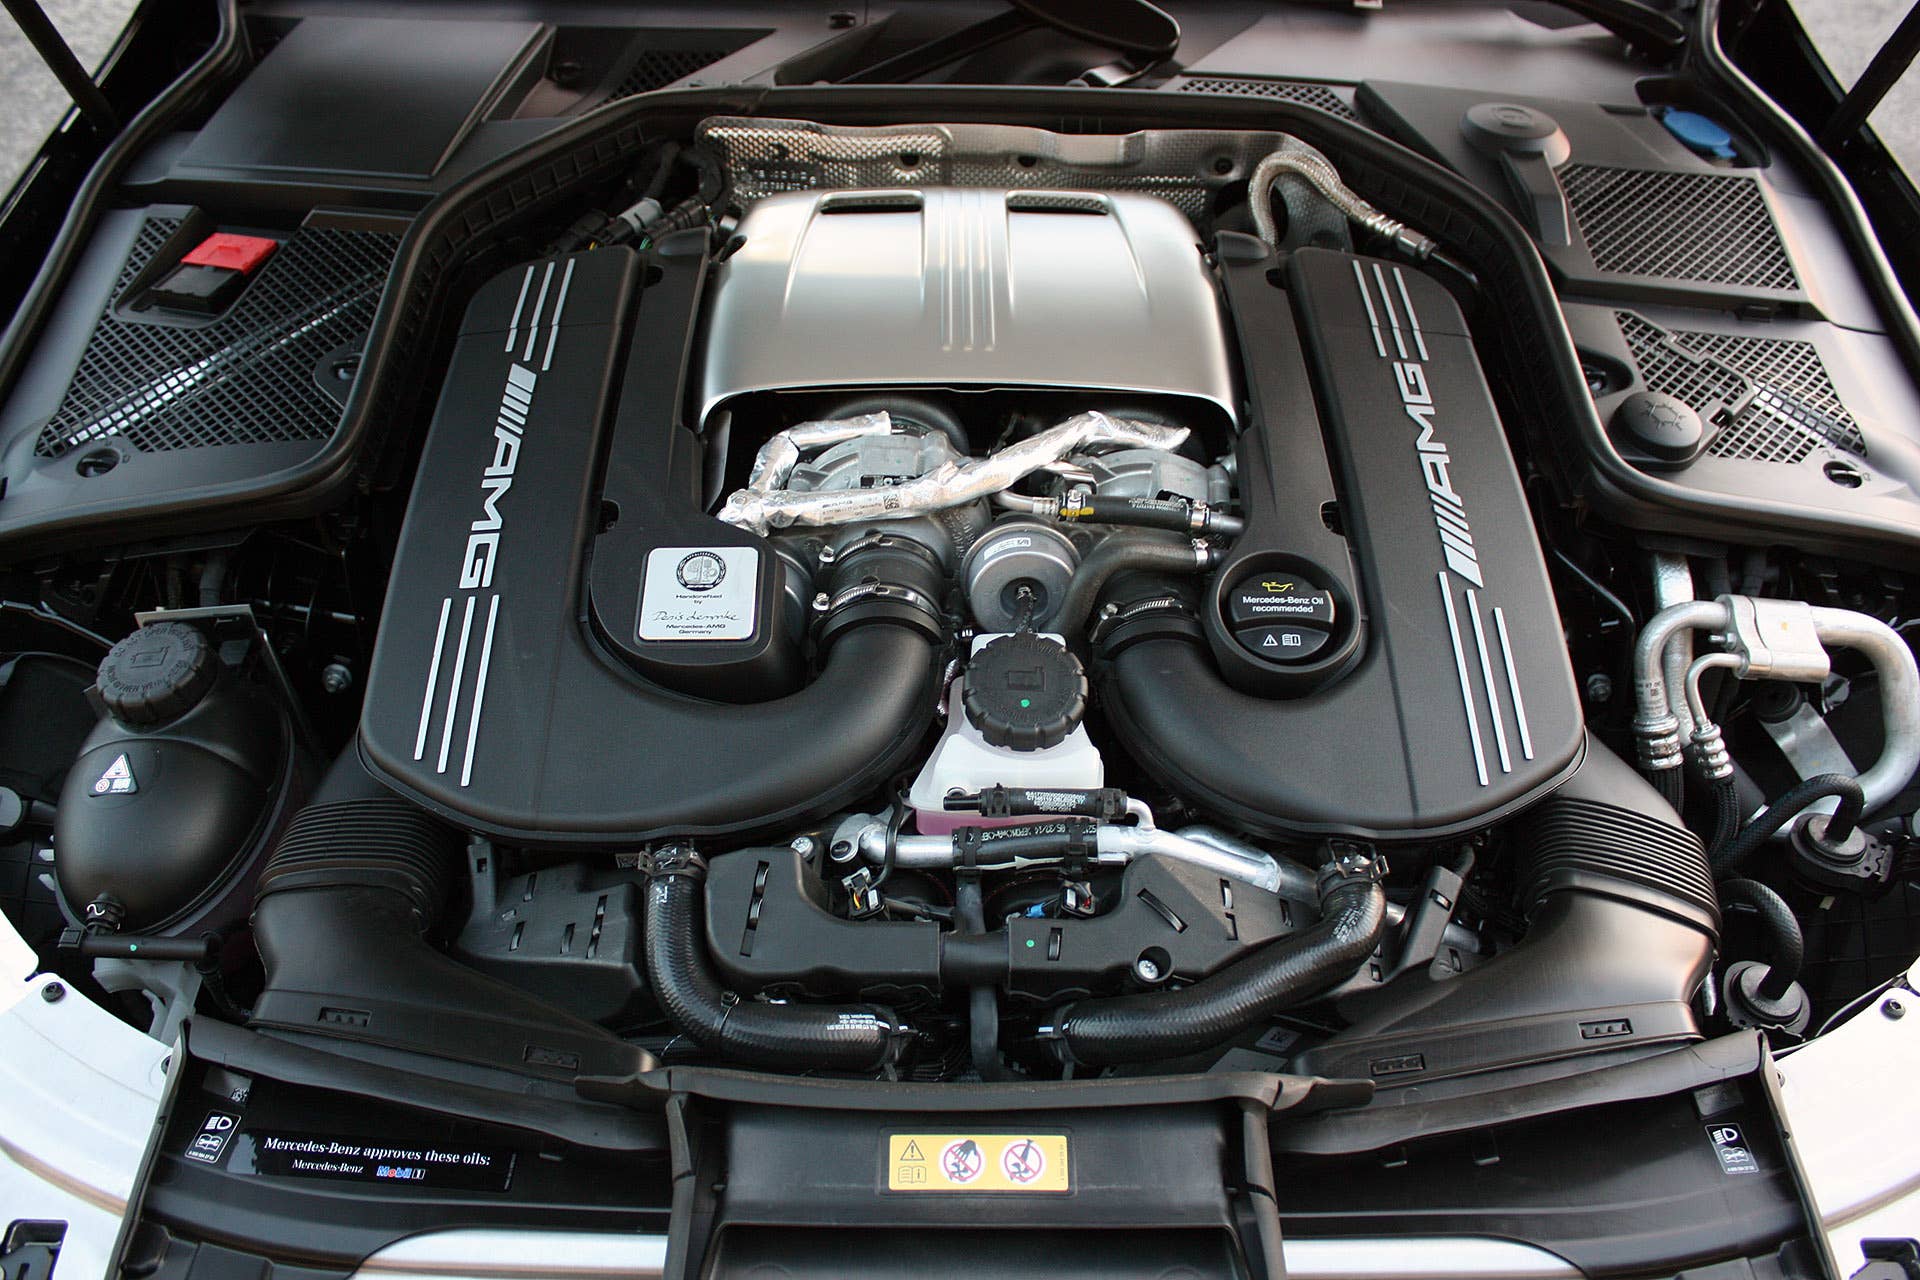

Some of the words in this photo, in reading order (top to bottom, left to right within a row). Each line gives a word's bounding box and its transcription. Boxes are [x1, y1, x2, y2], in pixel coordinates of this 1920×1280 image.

[1392, 361, 1463, 507] AMG
[458, 425, 522, 589] AMG
[1242, 596, 1310, 604] Mercedes-Benz
[1311, 596, 1324, 605] Oil
[1252, 604, 1314, 613] recommended
[263, 1137, 361, 1157] Mercedes-Benz
[363, 1146, 421, 1161] approves
[424, 1149, 460, 1164] these
[291, 1159, 364, 1174] Mercedes-Benz
[376, 1165, 412, 1178] Mobil
